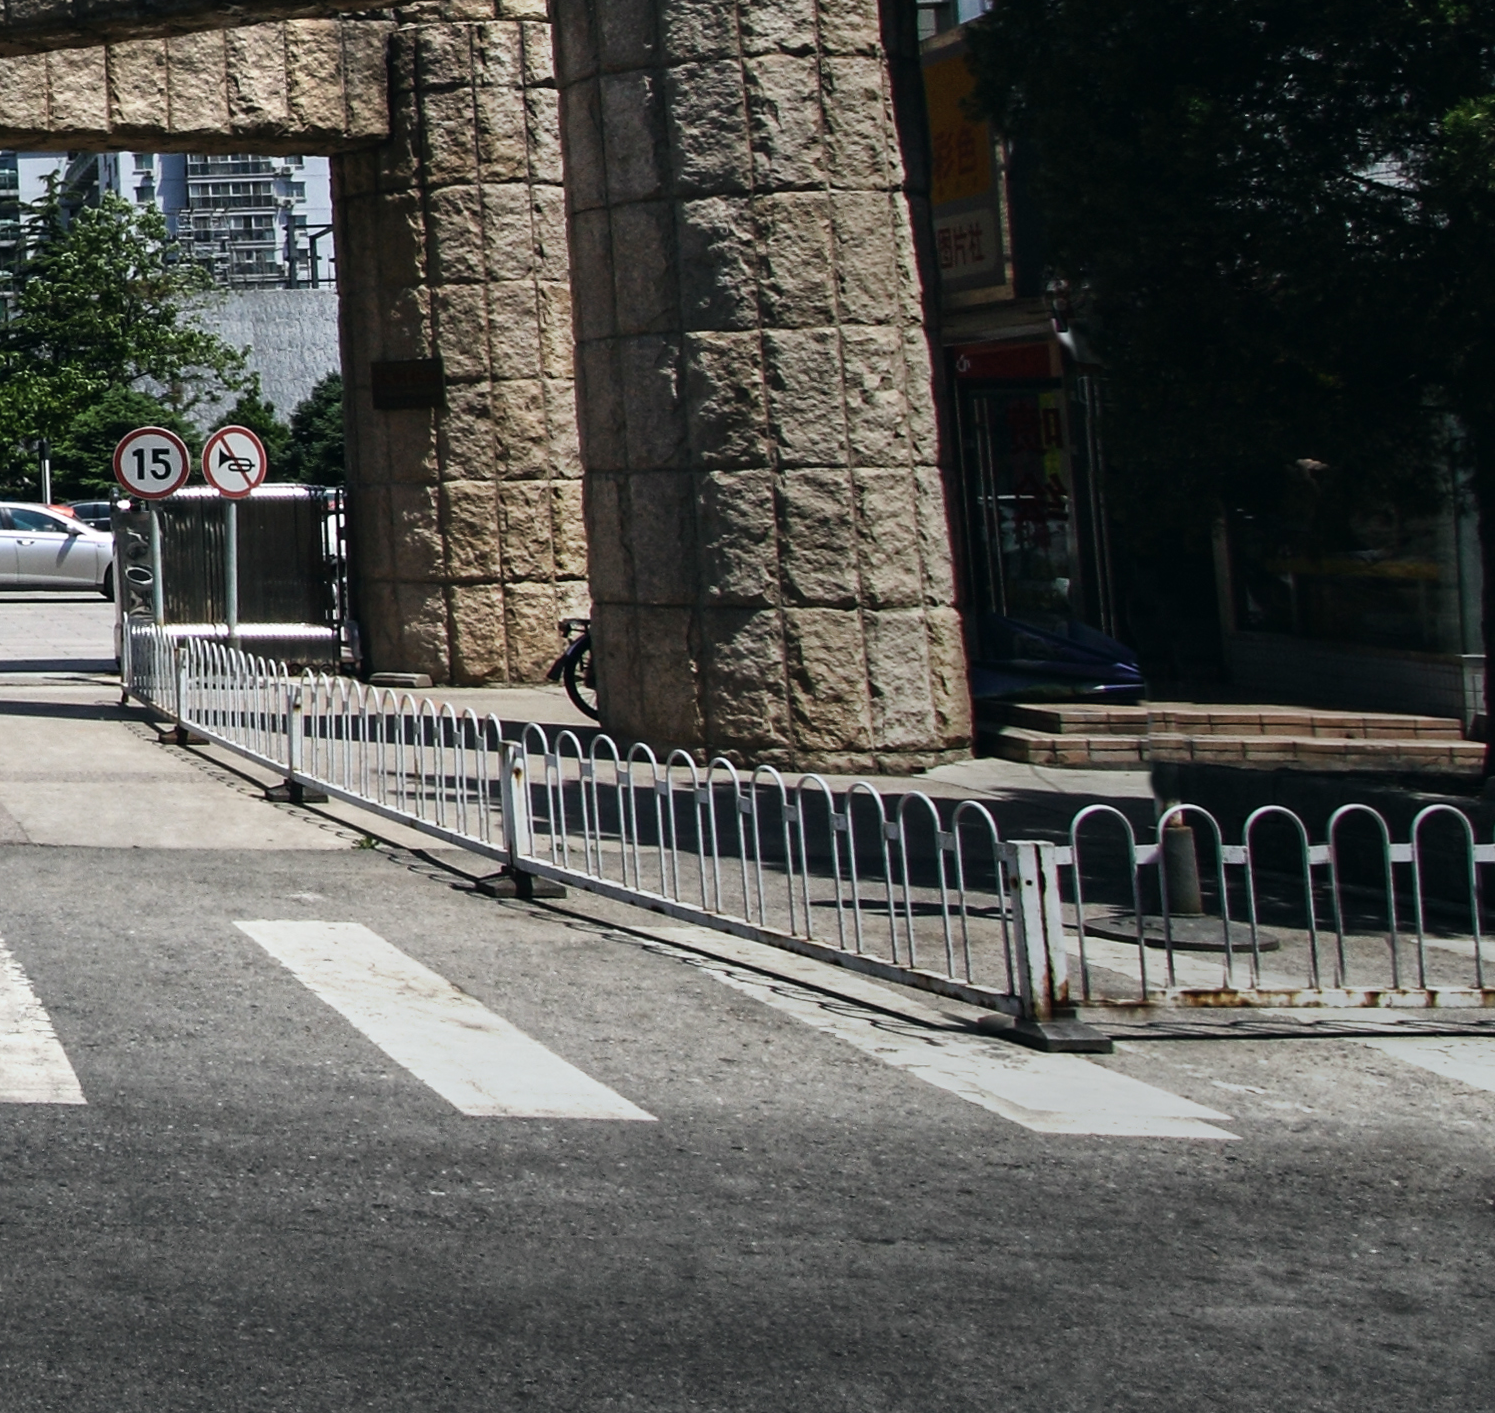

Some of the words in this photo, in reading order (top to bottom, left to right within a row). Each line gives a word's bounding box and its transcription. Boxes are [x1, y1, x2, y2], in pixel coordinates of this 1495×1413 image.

[938, 221, 984, 269] 图片社
[132, 448, 172, 480] 15
